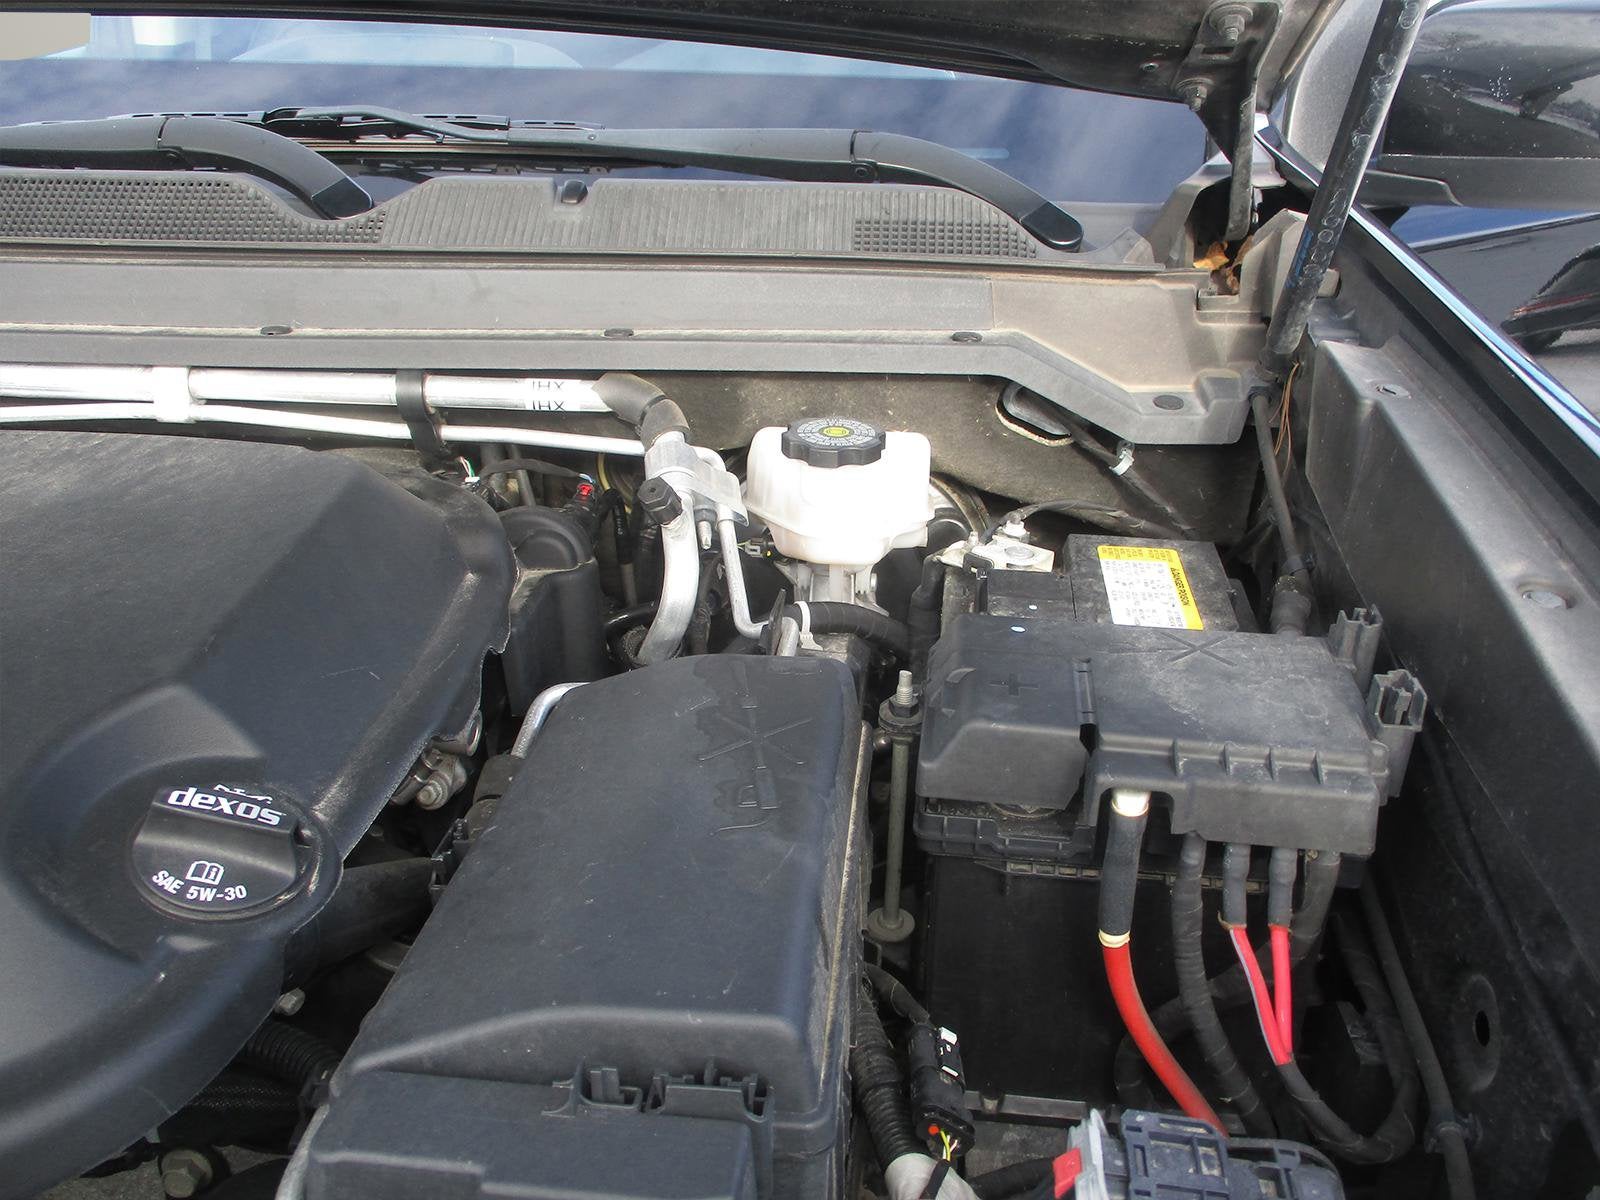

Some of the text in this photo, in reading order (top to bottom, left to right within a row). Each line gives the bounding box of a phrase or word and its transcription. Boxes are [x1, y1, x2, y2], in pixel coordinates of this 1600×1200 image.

[532, 400, 567, 410] IHX
[168, 787, 281, 826] dexos
[152, 870, 247, 901] SAE 5W-30
